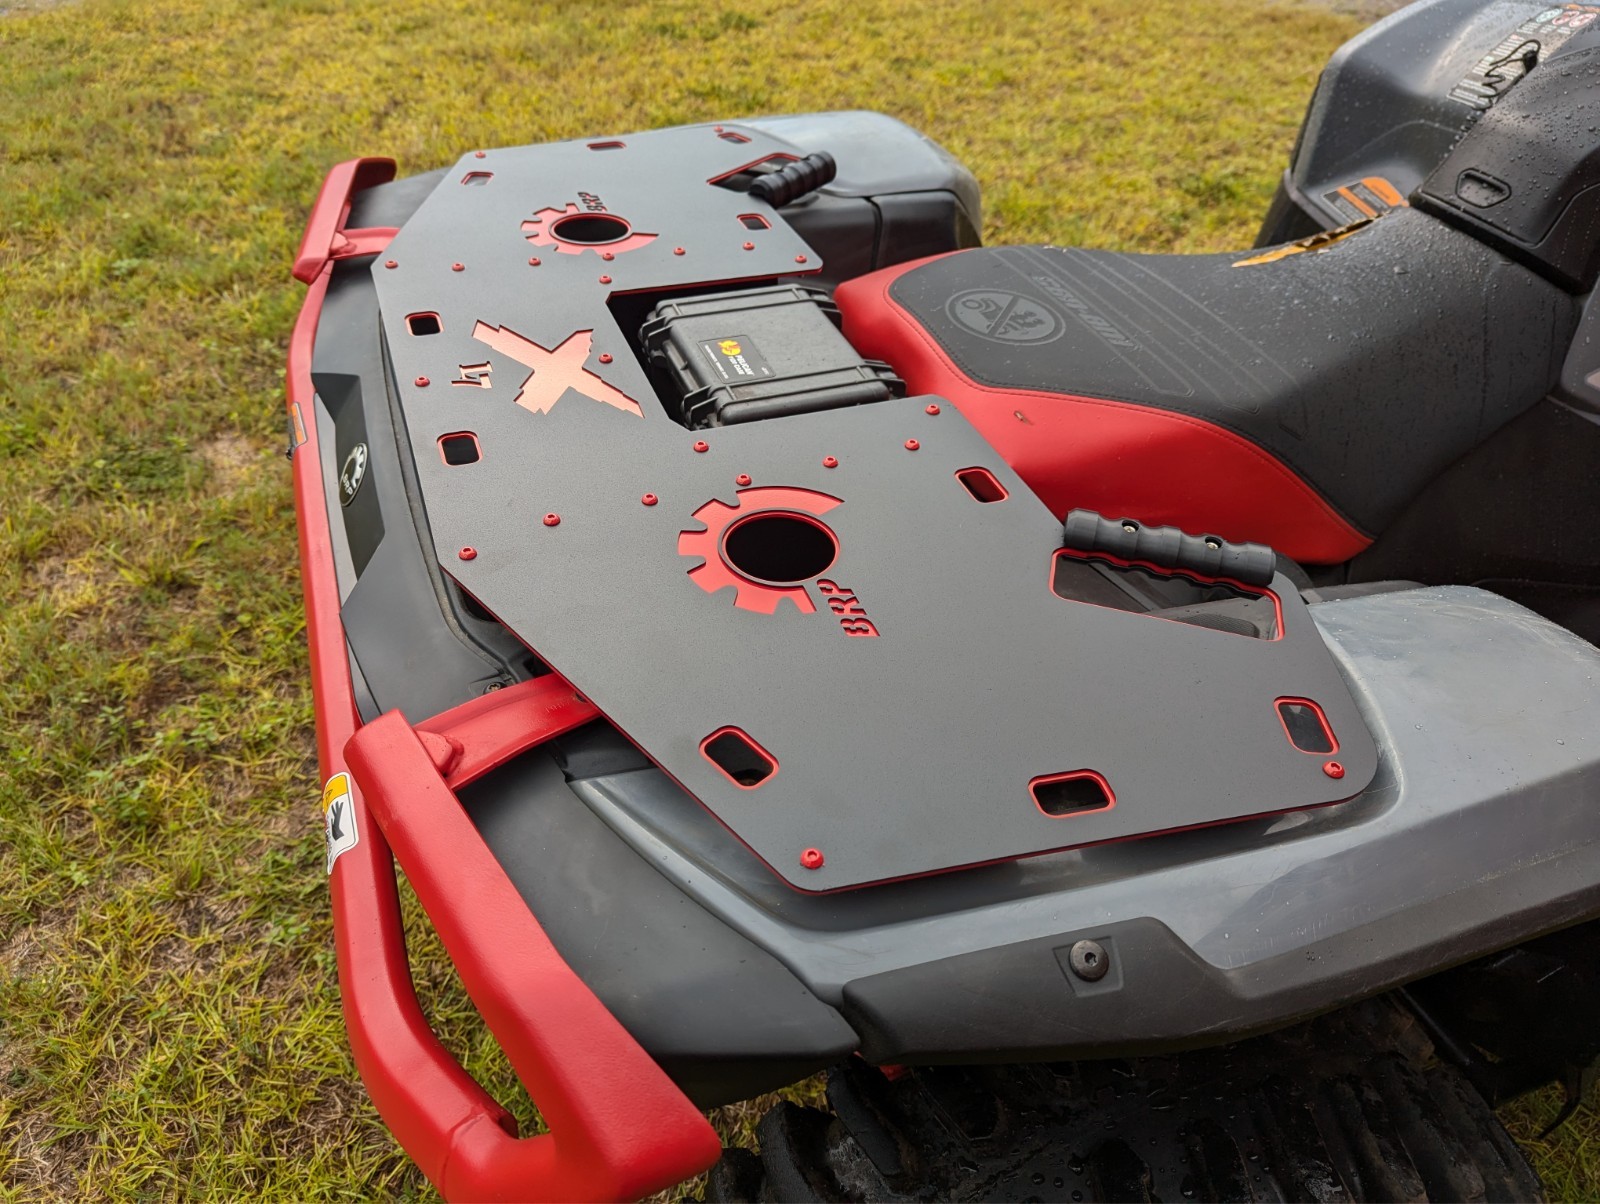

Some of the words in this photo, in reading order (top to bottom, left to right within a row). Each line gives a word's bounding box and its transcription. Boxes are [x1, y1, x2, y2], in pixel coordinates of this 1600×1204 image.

[577, 191, 608, 213] BRP
[342, 473, 354, 495] BRP
[816, 578, 881, 637] BRP
